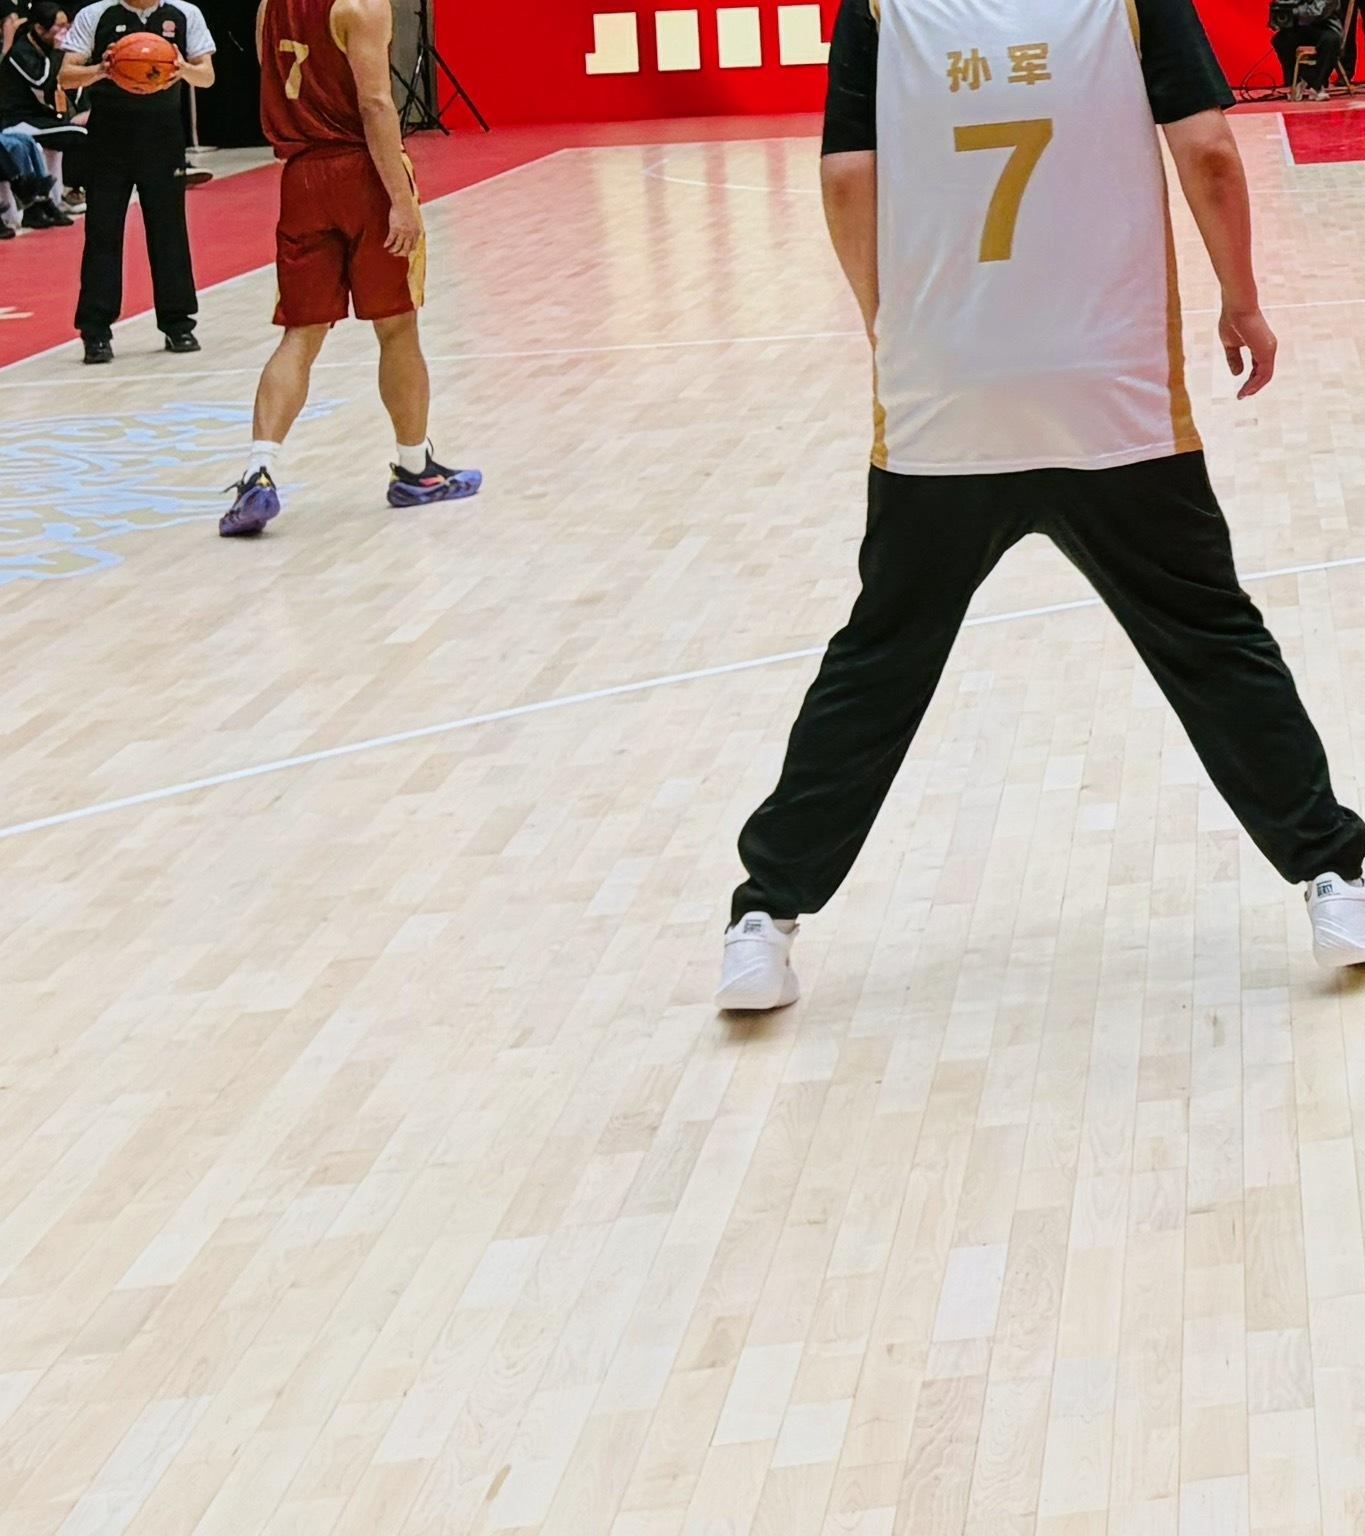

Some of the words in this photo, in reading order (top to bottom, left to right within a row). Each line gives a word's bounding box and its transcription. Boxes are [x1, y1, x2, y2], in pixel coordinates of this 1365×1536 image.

[278, 39, 309, 100] 7
[946, 42, 1052, 92] 孙军
[953, 118, 1053, 264] 7
